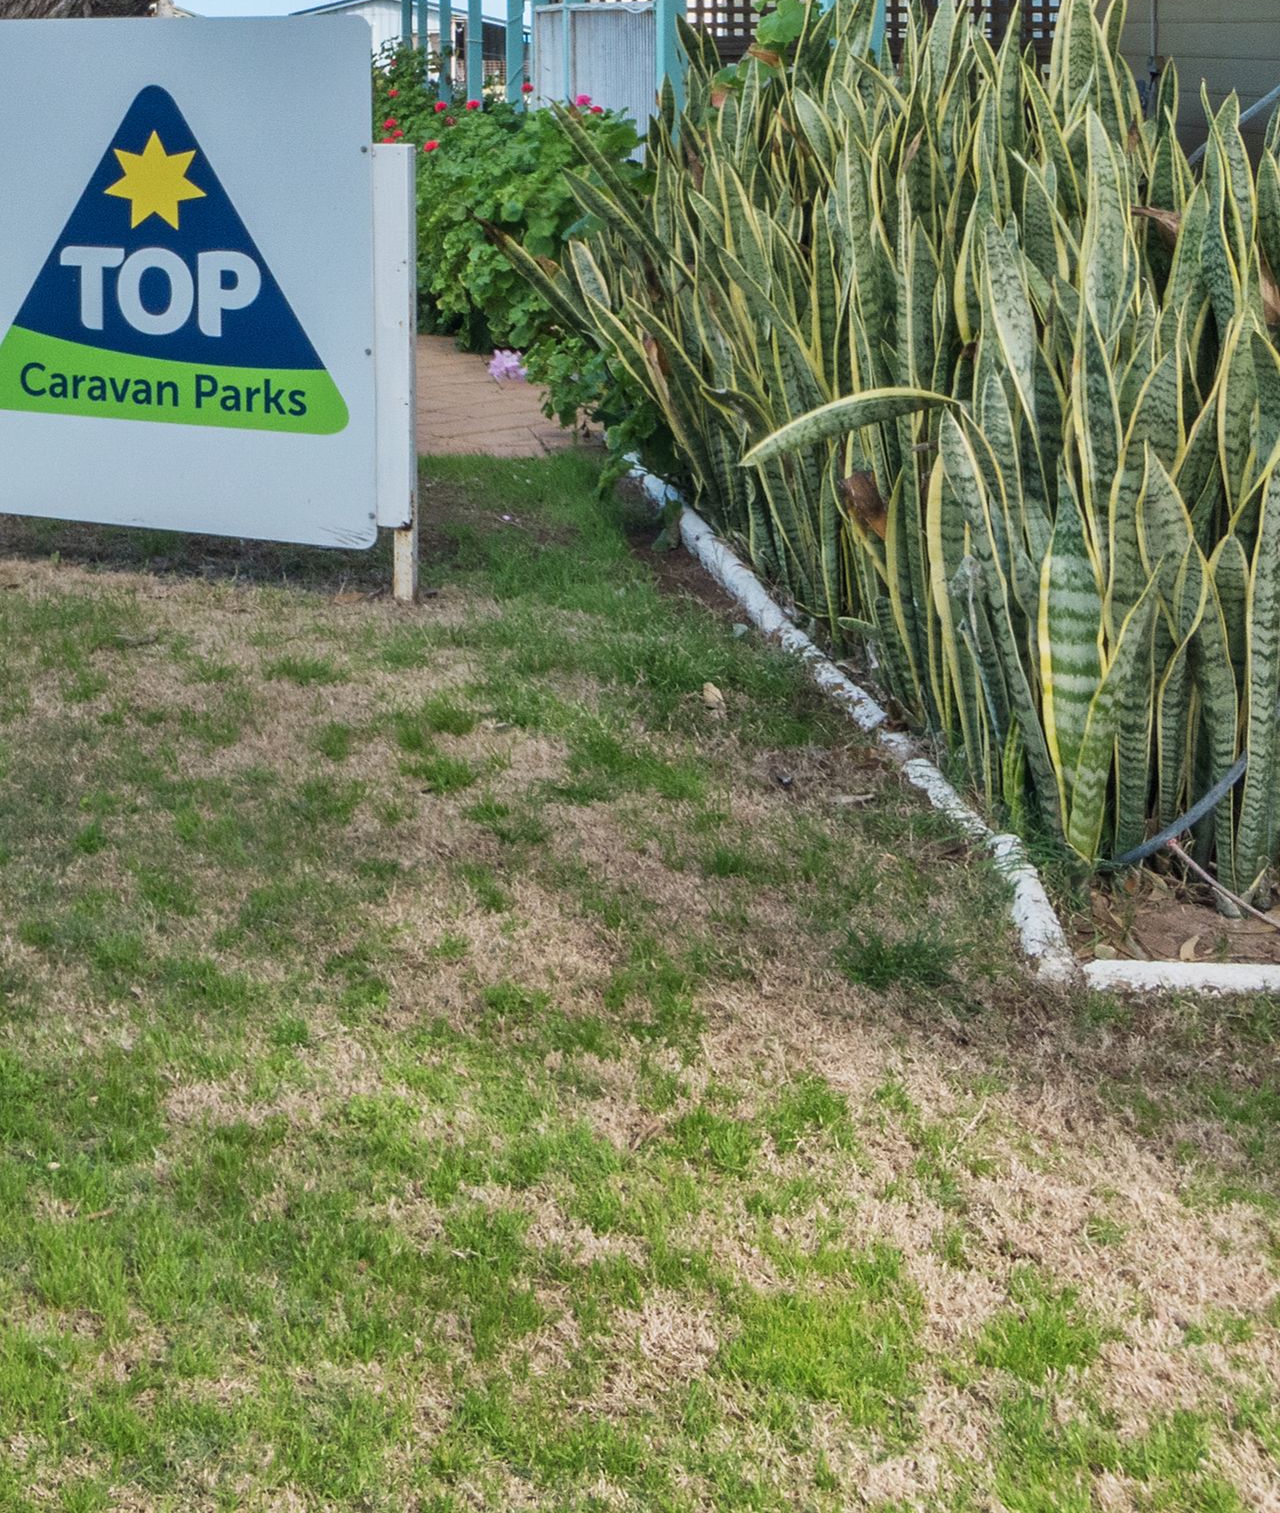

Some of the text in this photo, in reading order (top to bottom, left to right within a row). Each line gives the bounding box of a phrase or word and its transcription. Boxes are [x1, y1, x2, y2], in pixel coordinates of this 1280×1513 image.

[59, 245, 262, 338] TOP
[19, 361, 308, 417] Caravan Parks
